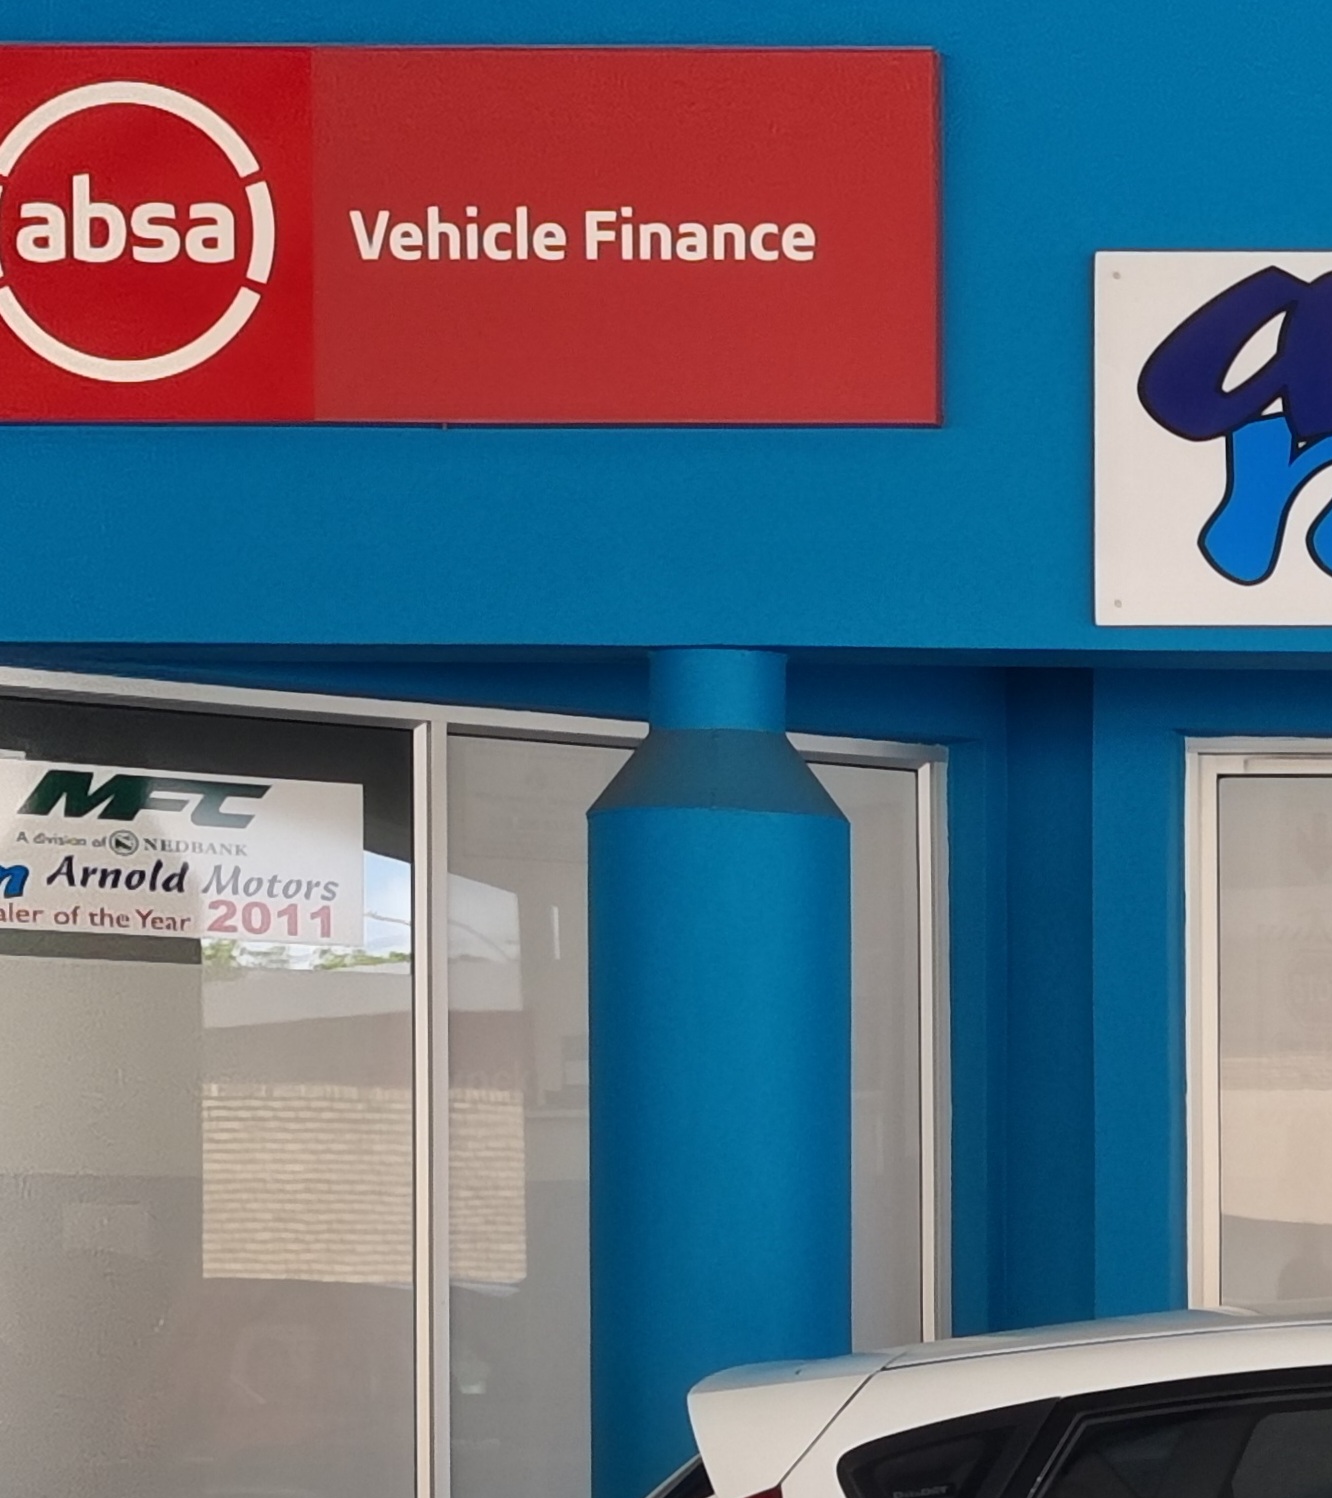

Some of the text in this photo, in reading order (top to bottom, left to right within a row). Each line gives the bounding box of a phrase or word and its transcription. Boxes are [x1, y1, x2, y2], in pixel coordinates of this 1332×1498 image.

[16, 173, 236, 264] absa
[349, 206, 816, 262] Vehicle Finance
[16, 769, 273, 829] MFC
[16, 831, 28, 843] A
[143, 837, 248, 857] NEDBANK
[46, 855, 190, 893] Arnold
[201, 863, 340, 902] Motors
[53, 905, 80, 926] of
[88, 907, 131, 929] the
[135, 908, 191, 932] Year
[206, 899, 332, 939] 2011
